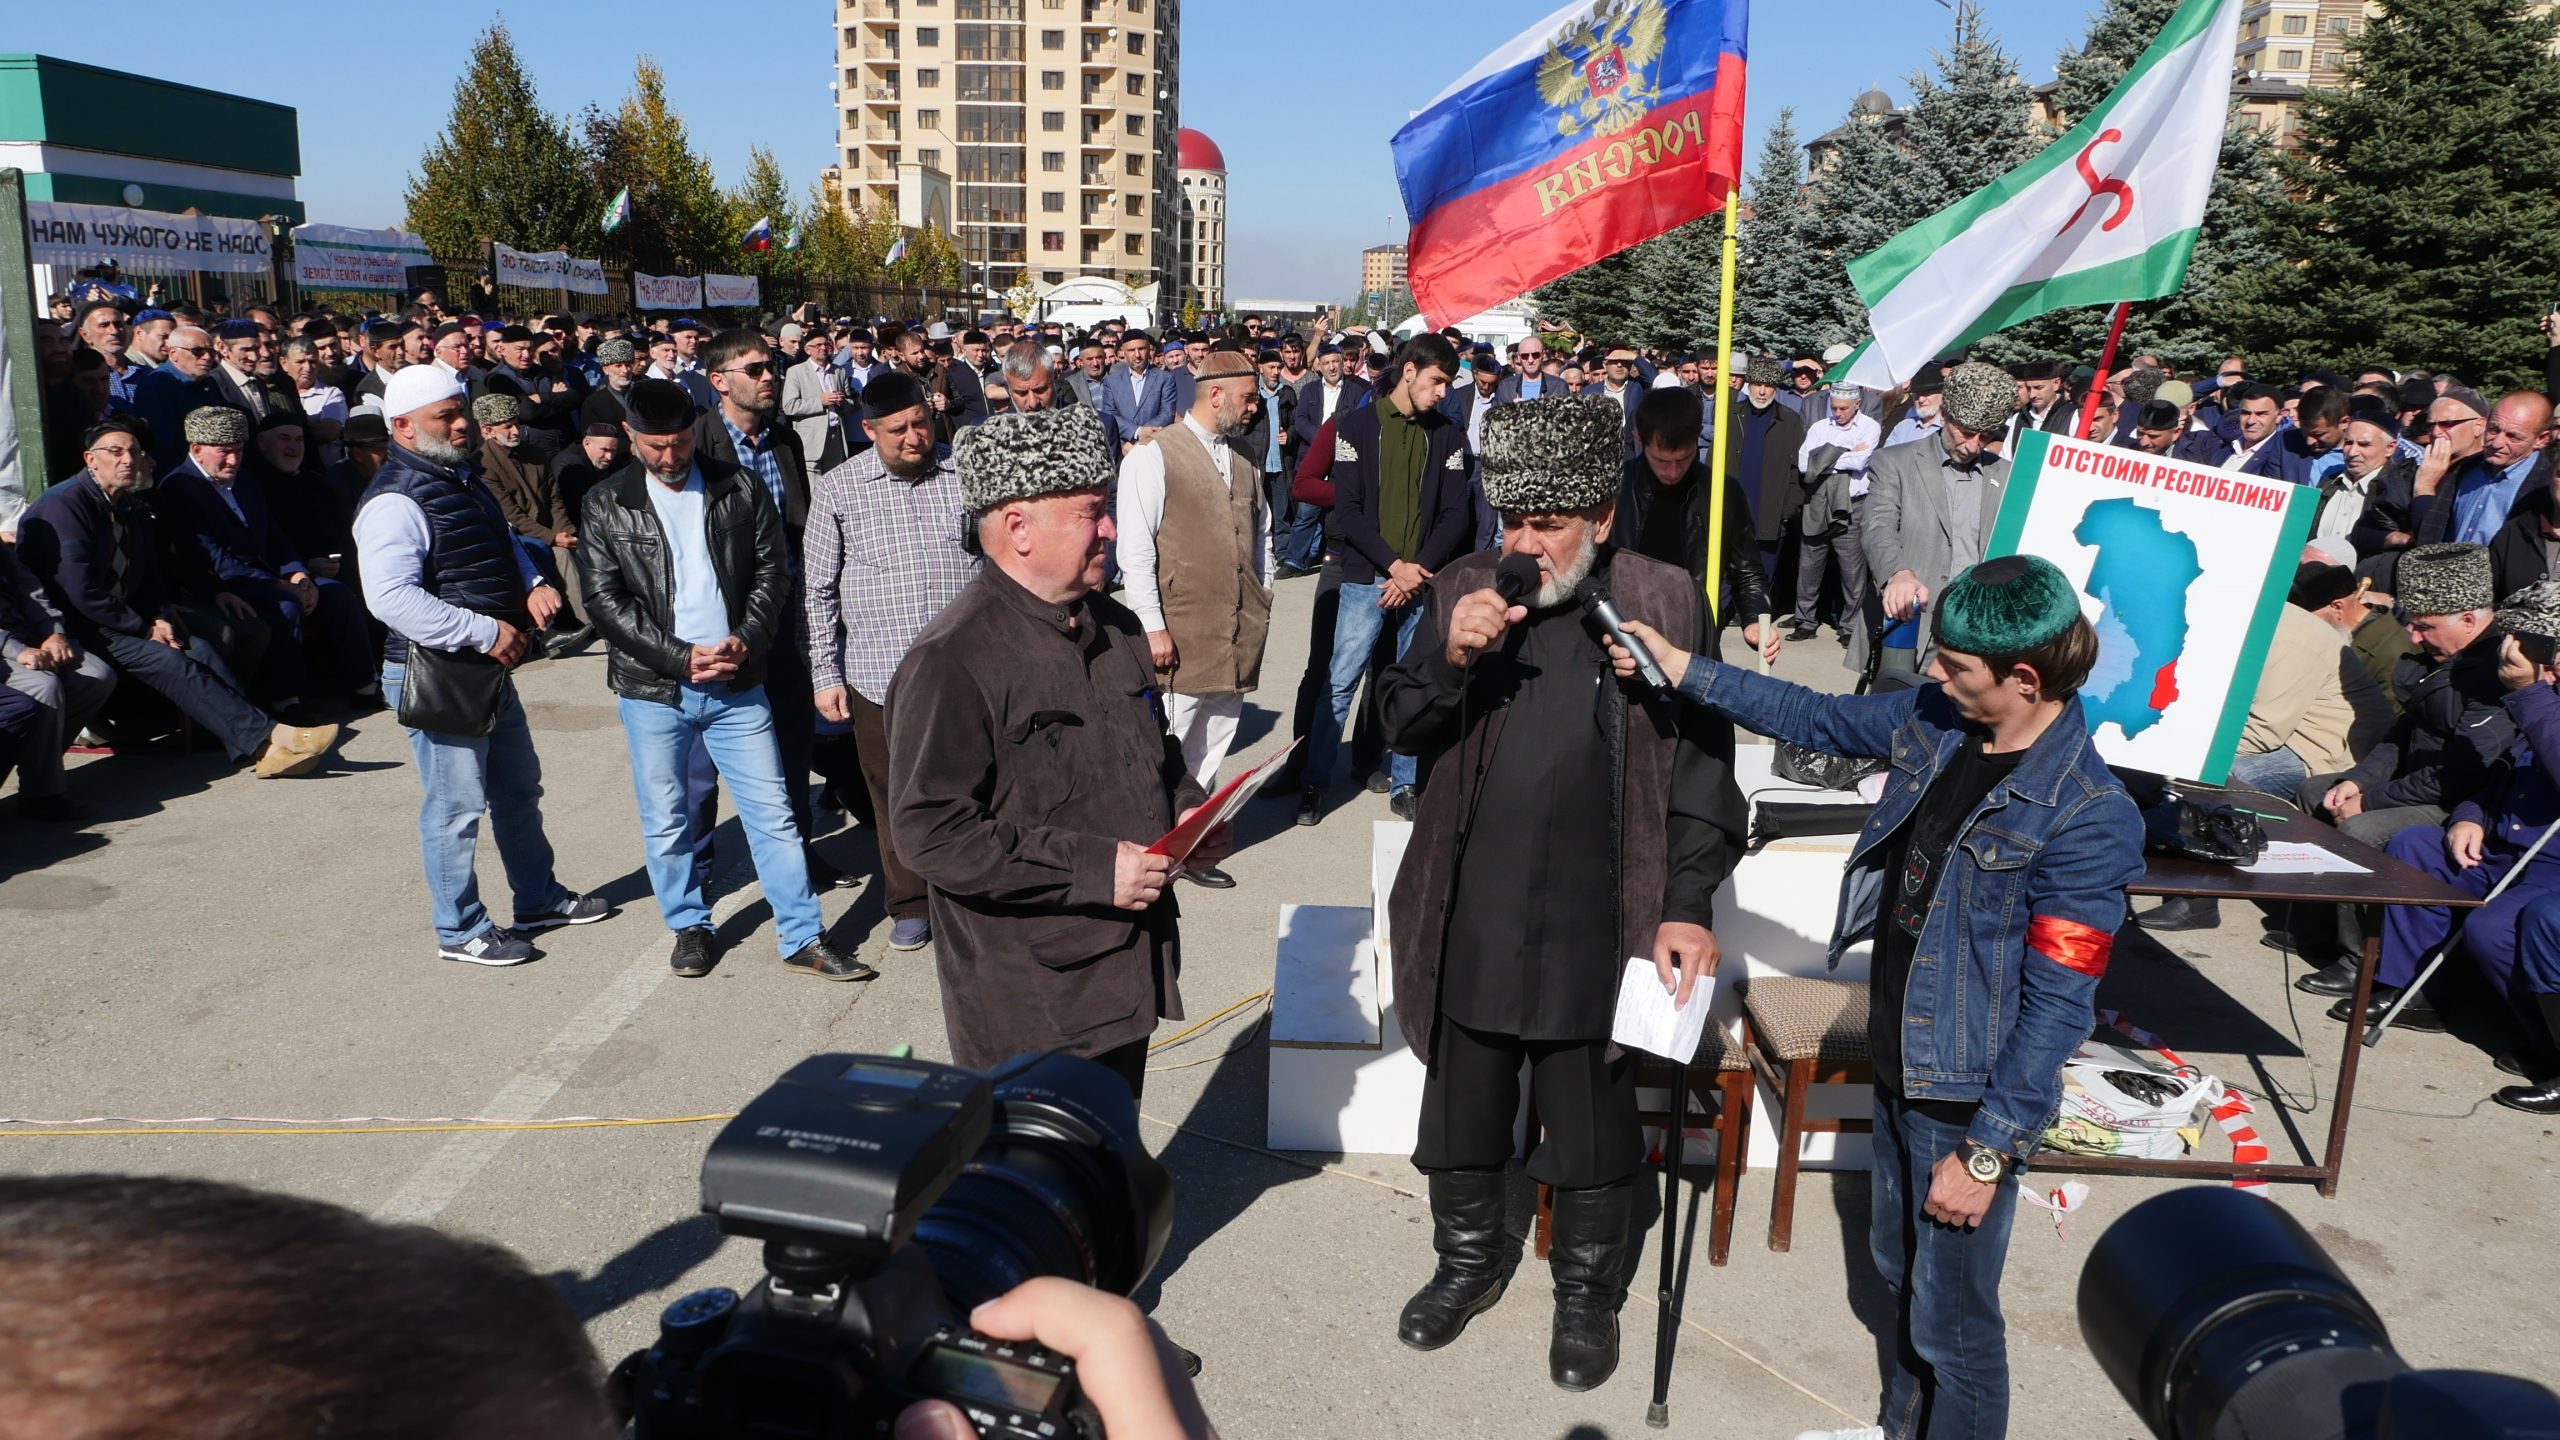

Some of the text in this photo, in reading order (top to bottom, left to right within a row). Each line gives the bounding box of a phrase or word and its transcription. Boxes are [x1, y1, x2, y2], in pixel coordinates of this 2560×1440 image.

[31, 219, 86, 245] НАМ
[92, 223, 180, 250] ЧУЖОГО
[185, 231, 213, 252] НЕ
[2048, 444, 2287, 512] ОТСТОИМ РЕСПУБЛИКУ
[464, 938, 489, 956] N
[781, 1129, 881, 1151] SENNHEISER
